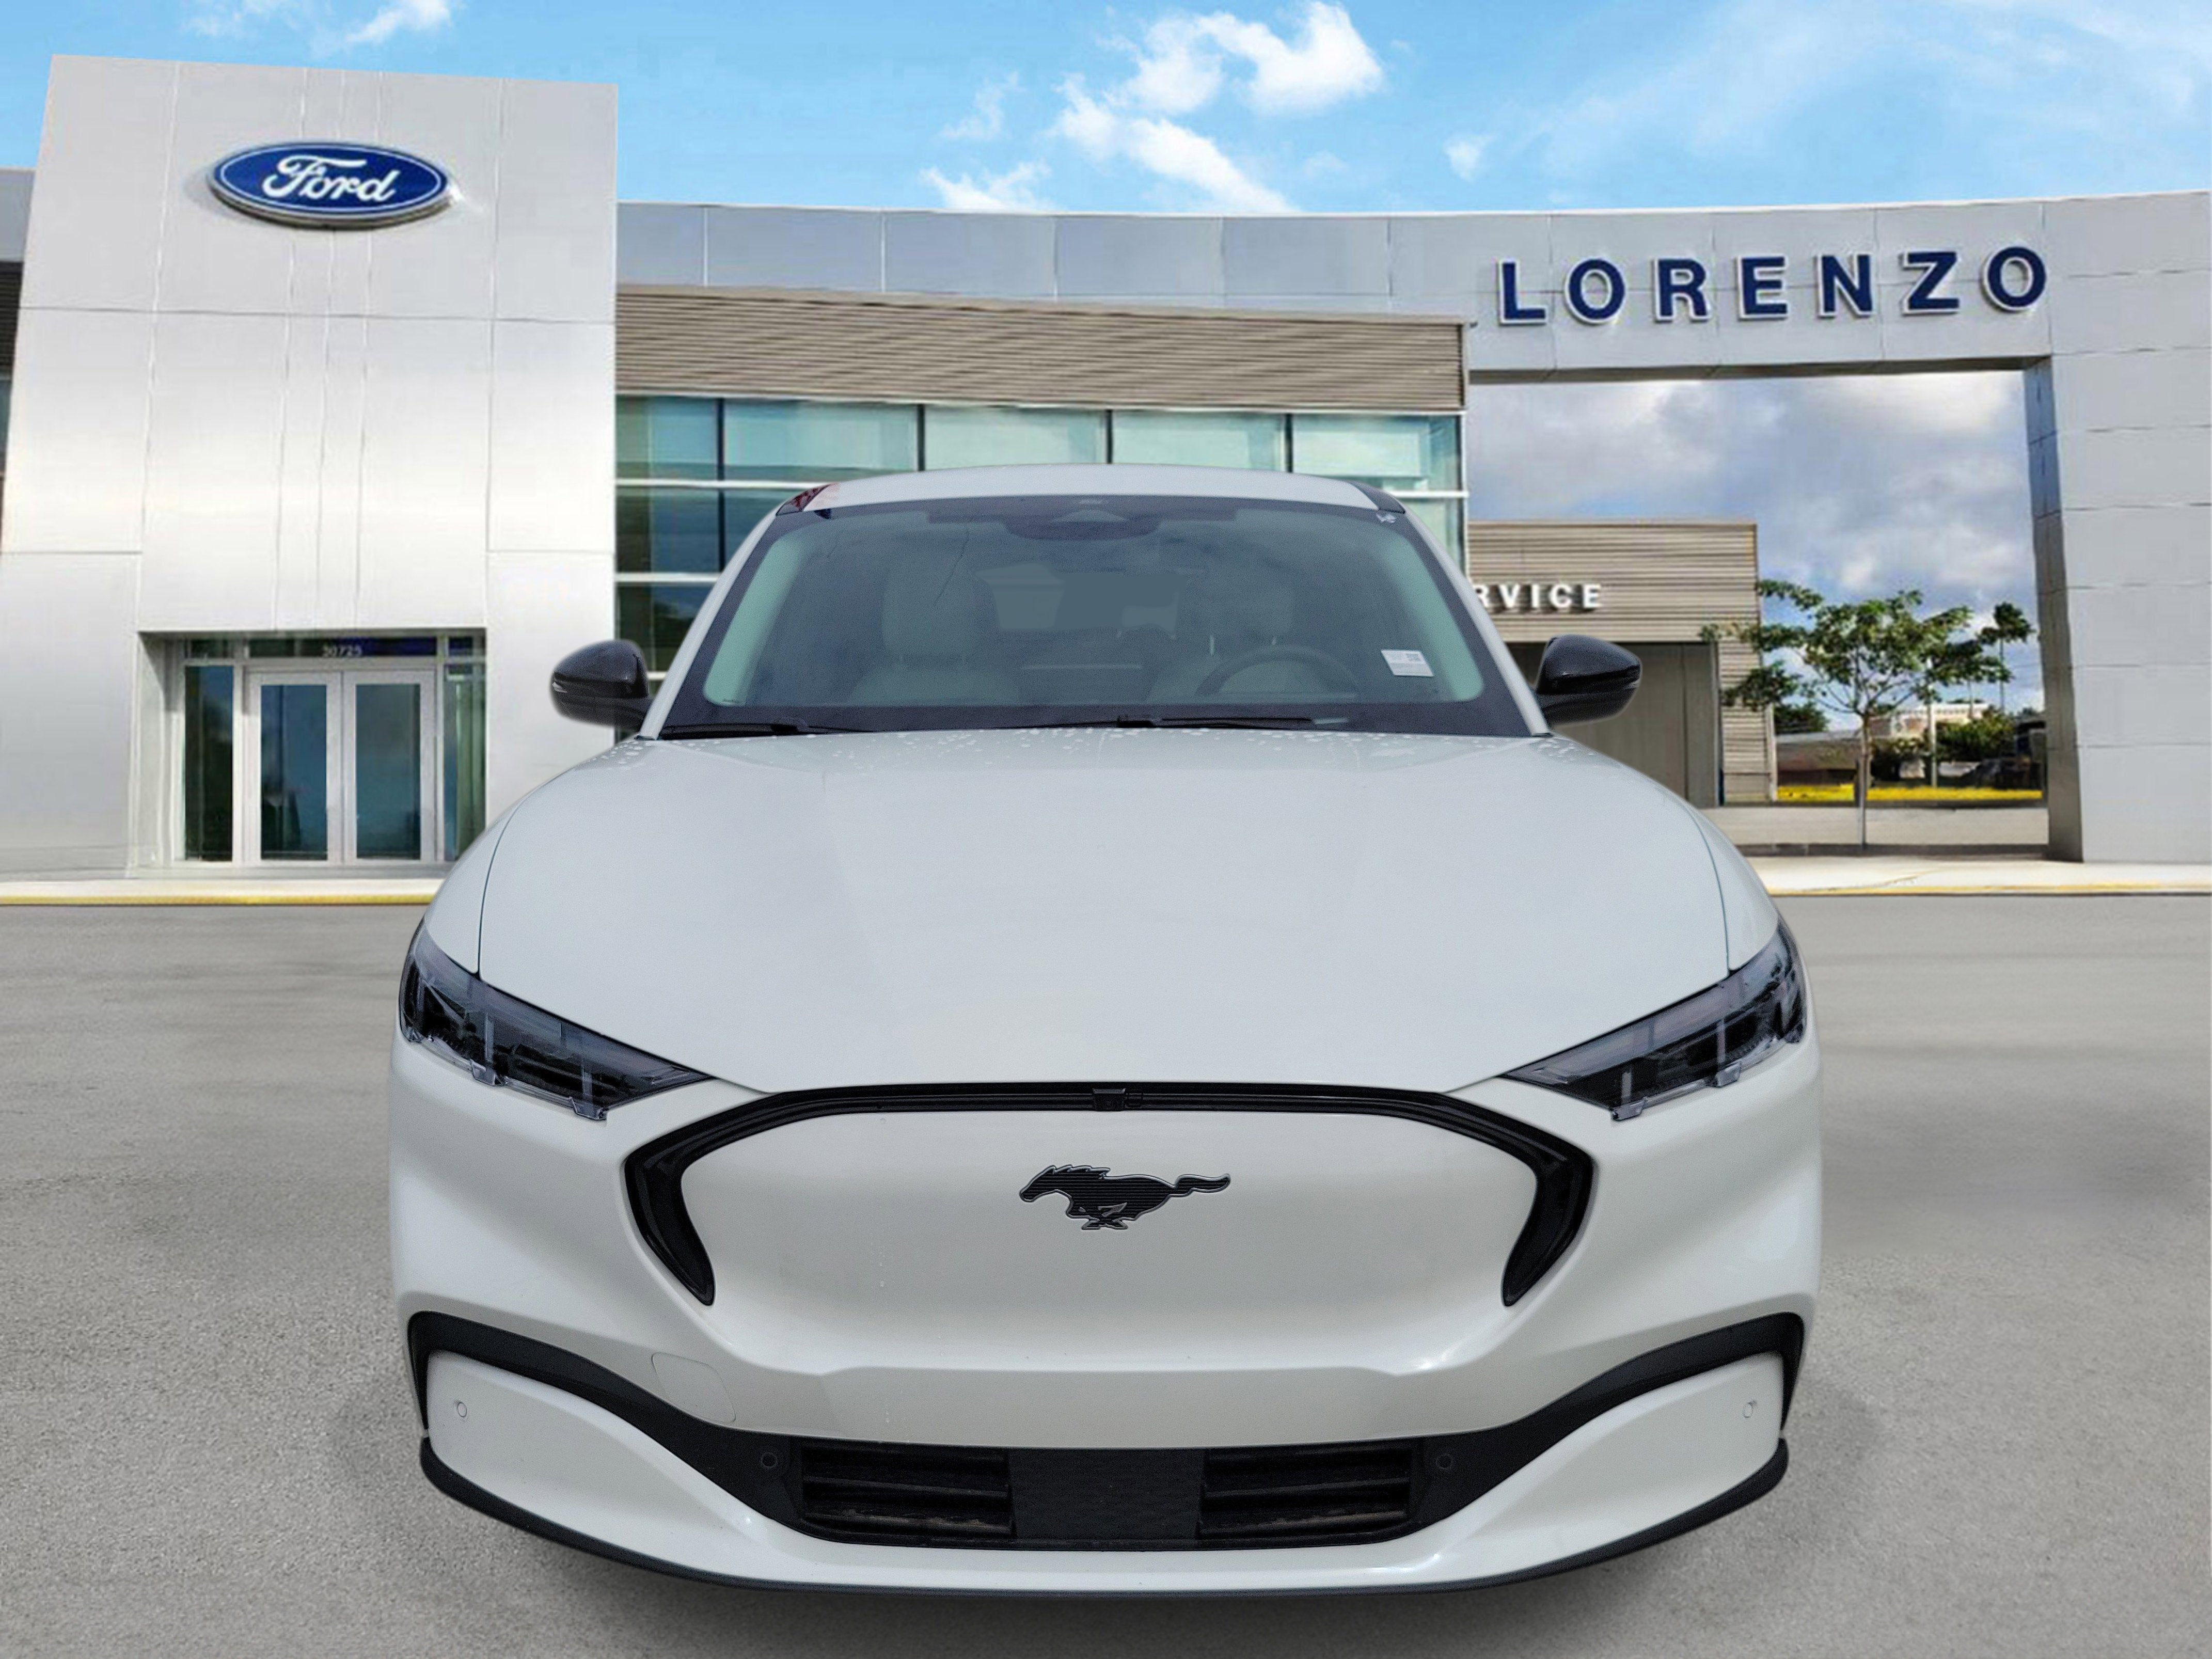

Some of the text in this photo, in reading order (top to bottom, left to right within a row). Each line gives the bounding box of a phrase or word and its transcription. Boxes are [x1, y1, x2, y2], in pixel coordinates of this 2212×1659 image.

[262, 154, 401, 202] Ford
[1498, 246, 2047, 325] LORENZO
[1473, 583, 1601, 609] RVICE
